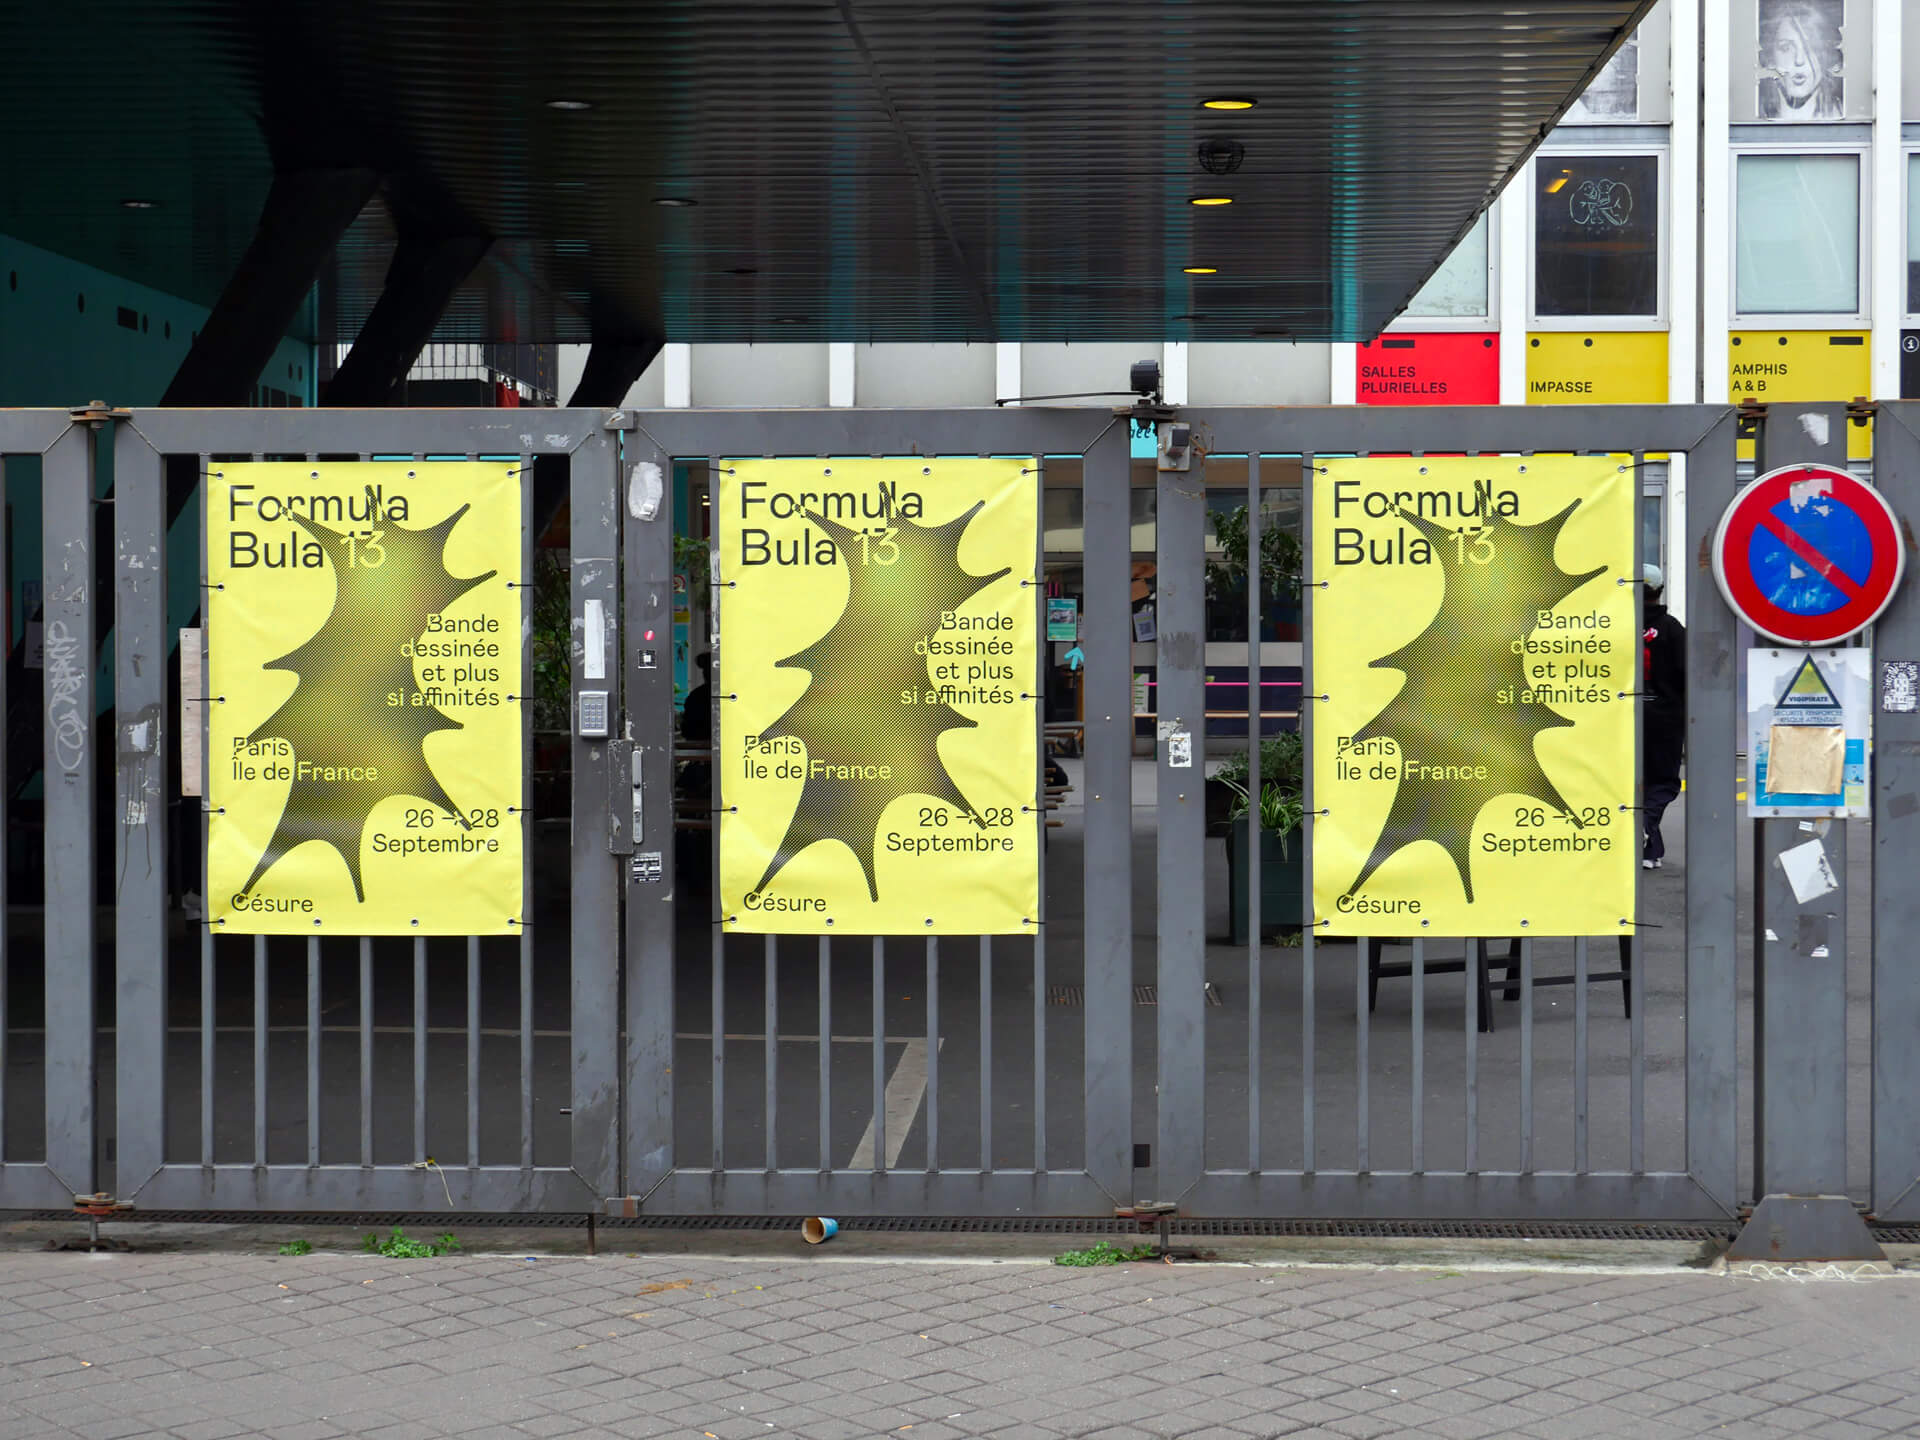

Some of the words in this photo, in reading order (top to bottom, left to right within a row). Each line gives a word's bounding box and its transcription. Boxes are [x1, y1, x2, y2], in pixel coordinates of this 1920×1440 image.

[1361, 366, 1416, 378] SALLES
[1732, 363, 1788, 376] AMPHIS
[1361, 382, 1448, 394] PLURIELLES
[1530, 381, 1593, 393] IMPASSE
[1732, 380, 1742, 392] A
[1744, 380, 1754, 392] &
[1757, 380, 1767, 392] B
[229, 484, 409, 522] Formula
[741, 481, 923, 519] Formula
[1334, 479, 1519, 518] Formula
[230, 531, 324, 568] Bula
[340, 531, 385, 568] 13
[742, 528, 837, 565] Bula
[853, 528, 899, 565] 13
[1335, 527, 1432, 565] Bula
[1448, 527, 1494, 564] 13
[427, 613, 499, 632] Bande
[941, 611, 1013, 630] Bande
[1537, 609, 1611, 628] Bande
[400, 638, 499, 657] dessinée
[914, 636, 1014, 655] dessinée
[1510, 634, 1611, 654] dessinée
[422, 664, 446, 682] et
[454, 662, 500, 686] plus
[936, 662, 960, 680] et
[968, 660, 1015, 684] plus
[1532, 661, 1557, 679] et
[1565, 659, 1612, 683] plus
[387, 688, 405, 706] si
[411, 686, 500, 706] affinités
[901, 686, 919, 704] si
[925, 684, 1015, 704] affinités
[1496, 685, 1515, 704] si
[1521, 683, 1612, 703] affinités
[233, 737, 289, 756] Paris
[745, 735, 802, 754] Paris
[1338, 736, 1396, 755] Paris
[232, 756, 256, 781] Île
[263, 761, 290, 781] de
[297, 761, 378, 781] France
[744, 754, 768, 780] Île
[775, 759, 803, 780] de
[810, 759, 892, 779] France
[1337, 756, 1362, 781] Île
[1369, 760, 1397, 781] de
[1404, 760, 1487, 780] France
[404, 808, 434, 828] 26
[470, 808, 500, 828] 28
[918, 807, 948, 827] 26
[985, 807, 1015, 827] 28
[1514, 807, 1545, 827] 26
[1582, 806, 1612, 826] 28
[372, 833, 499, 857] Septembre
[886, 832, 1014, 856] Septembre
[1481, 832, 1611, 856] Septembre
[231, 894, 314, 914] Césure
[743, 893, 827, 914] Césure
[1336, 896, 1421, 916] Césure
